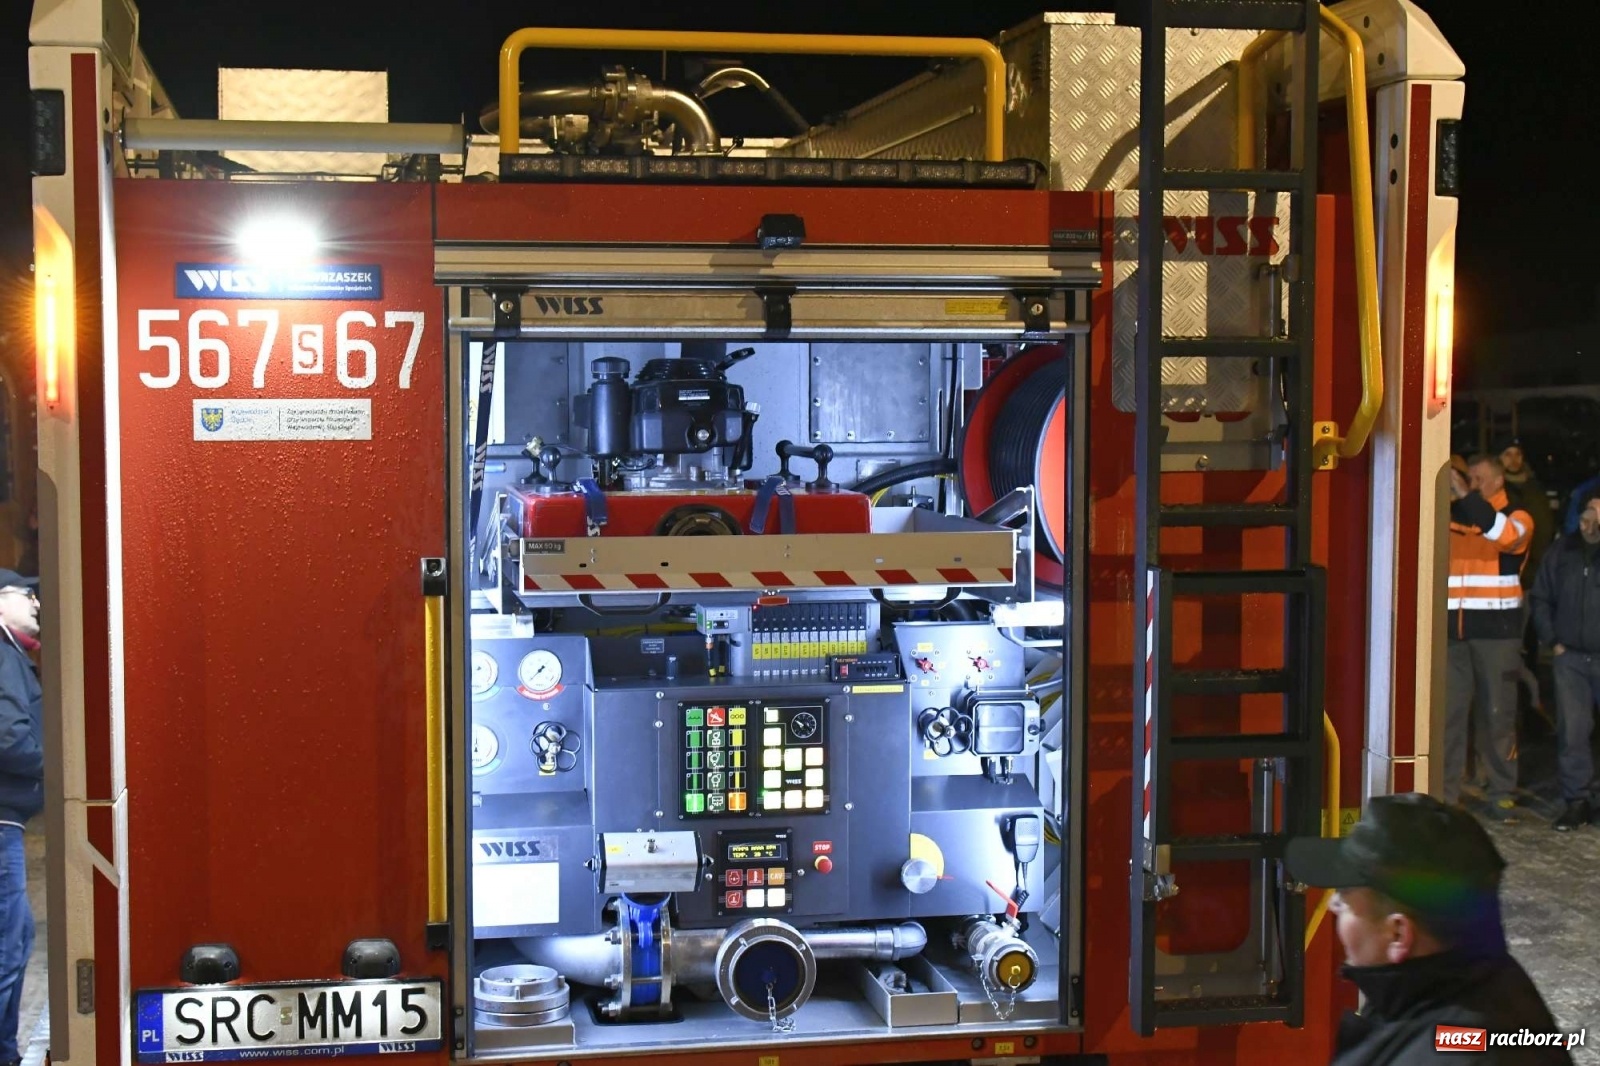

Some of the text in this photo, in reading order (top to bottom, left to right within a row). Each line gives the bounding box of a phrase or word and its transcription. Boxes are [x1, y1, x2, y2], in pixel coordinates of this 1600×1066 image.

[534, 296, 604, 315] WISS
[138, 309, 425, 389] 567 S 67
[528, 542, 543, 550] MAX
[480, 841, 541, 857] WISS
[175, 987, 428, 1044] SRC MM15
[142, 1029, 160, 1043] PL
[239, 1046, 345, 1058] www.wiss.com.pl
